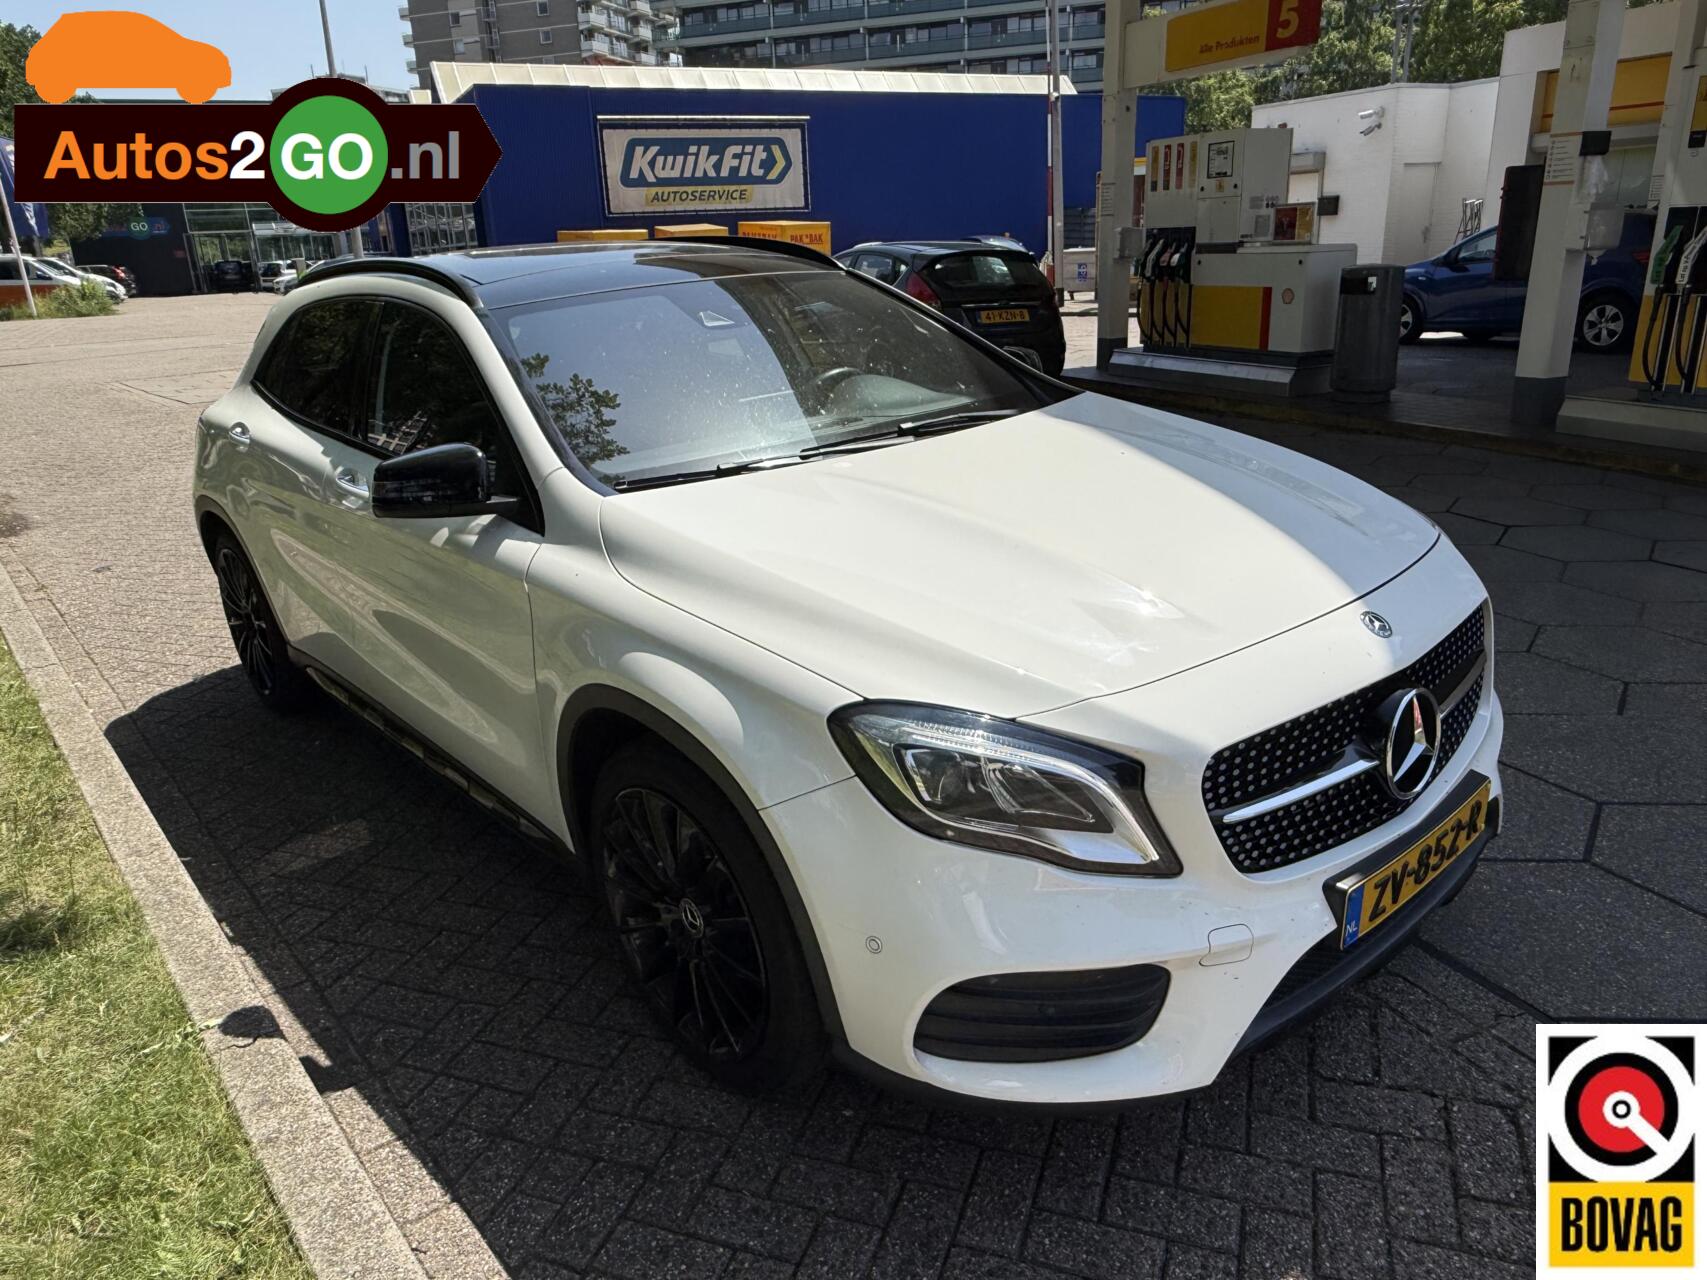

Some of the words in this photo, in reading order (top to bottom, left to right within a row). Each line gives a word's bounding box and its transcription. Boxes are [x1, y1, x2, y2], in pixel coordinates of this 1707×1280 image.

[1275, 0, 1299, 39] 5
[1215, 33, 1260, 52] Produkten
[651, 188, 749, 203] AUTOSERVICE
[1368, 799, 1483, 923] ZV-852-R
[1345, 923, 1359, 937] NL
